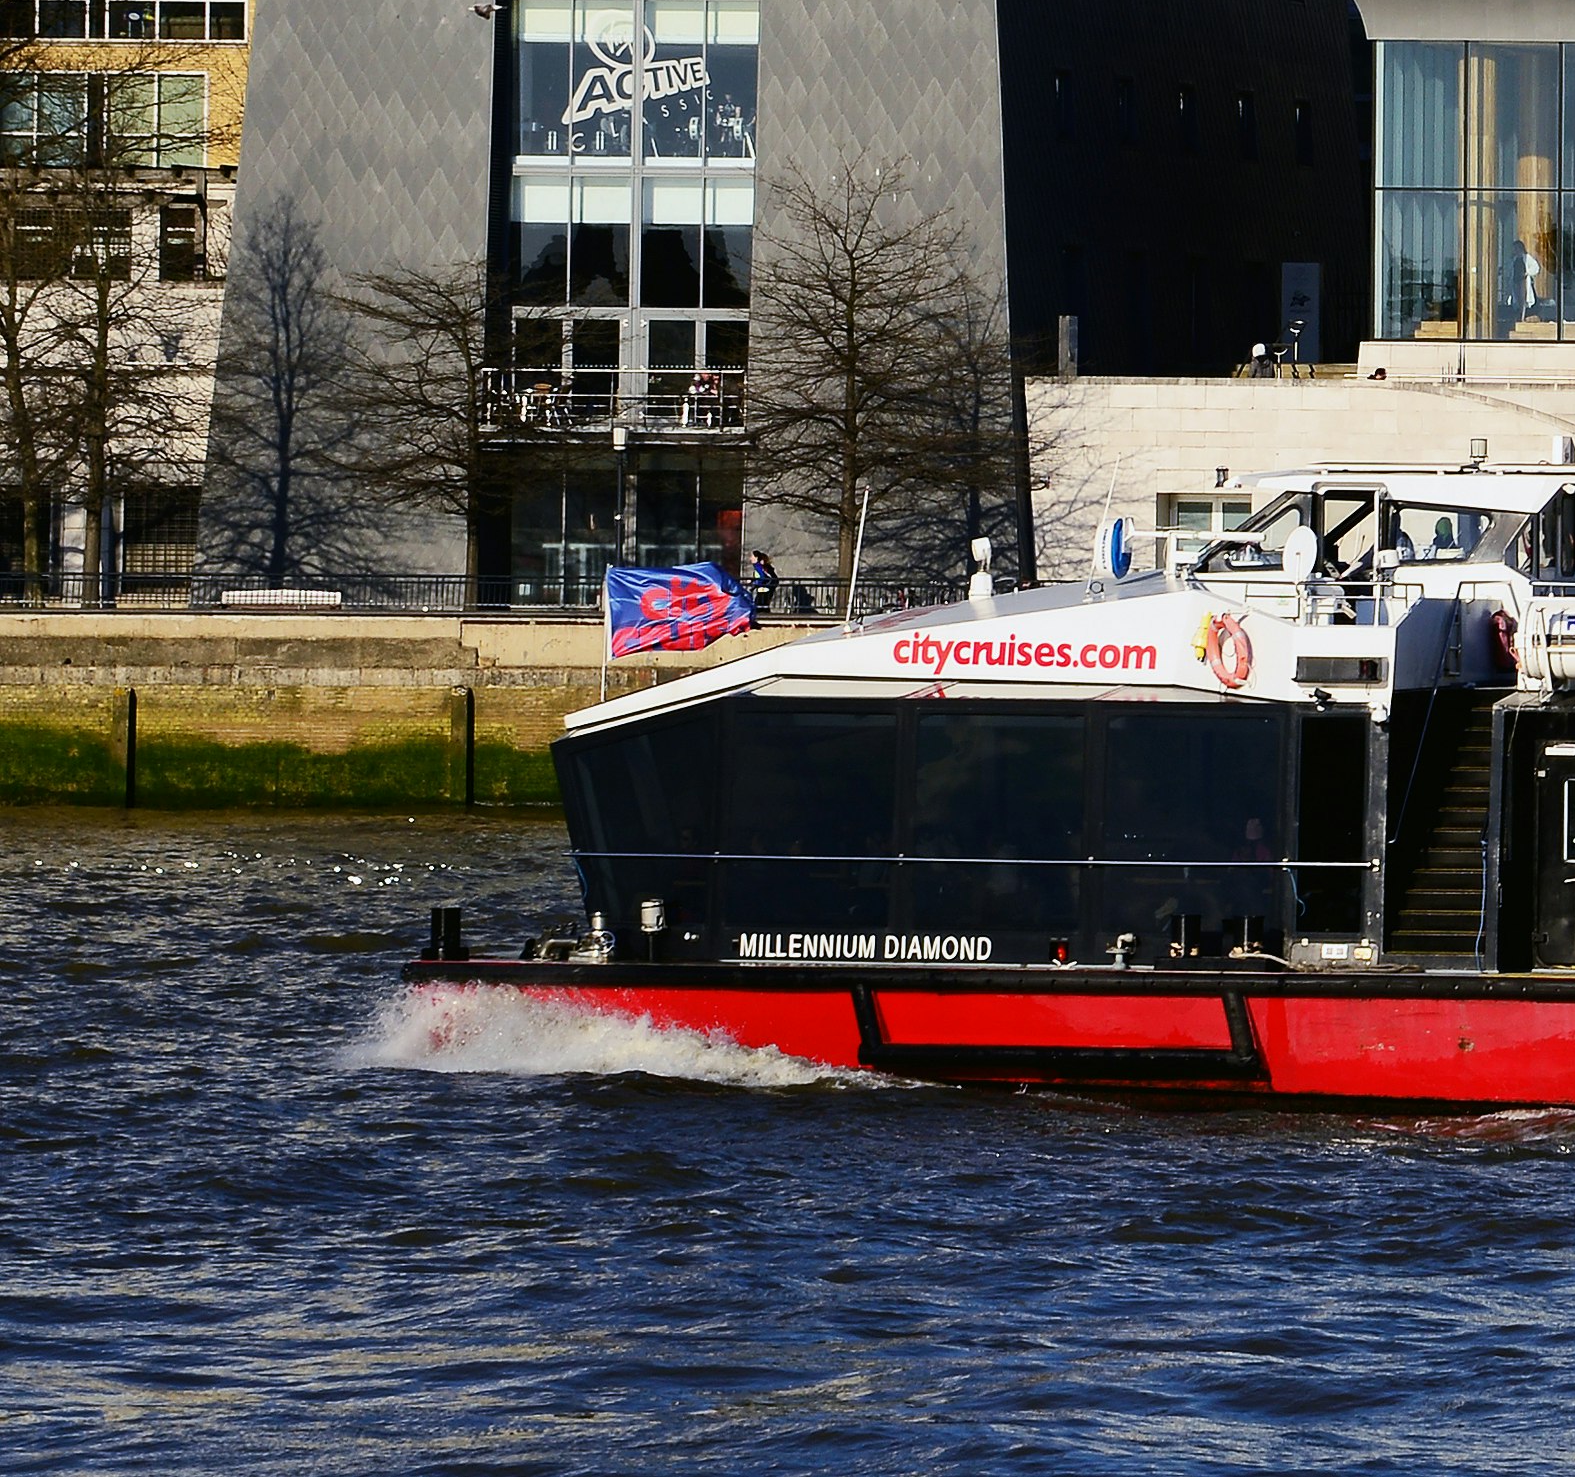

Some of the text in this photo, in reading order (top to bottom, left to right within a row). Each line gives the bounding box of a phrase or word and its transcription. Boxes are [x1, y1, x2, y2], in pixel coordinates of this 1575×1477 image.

[568, 58, 707, 121] ACTIVE
[571, 89, 714, 152] CLSSIC
[893, 631, 1157, 675] citycruises.com
[739, 932, 993, 961] MILLENNIUM DIAMOND
